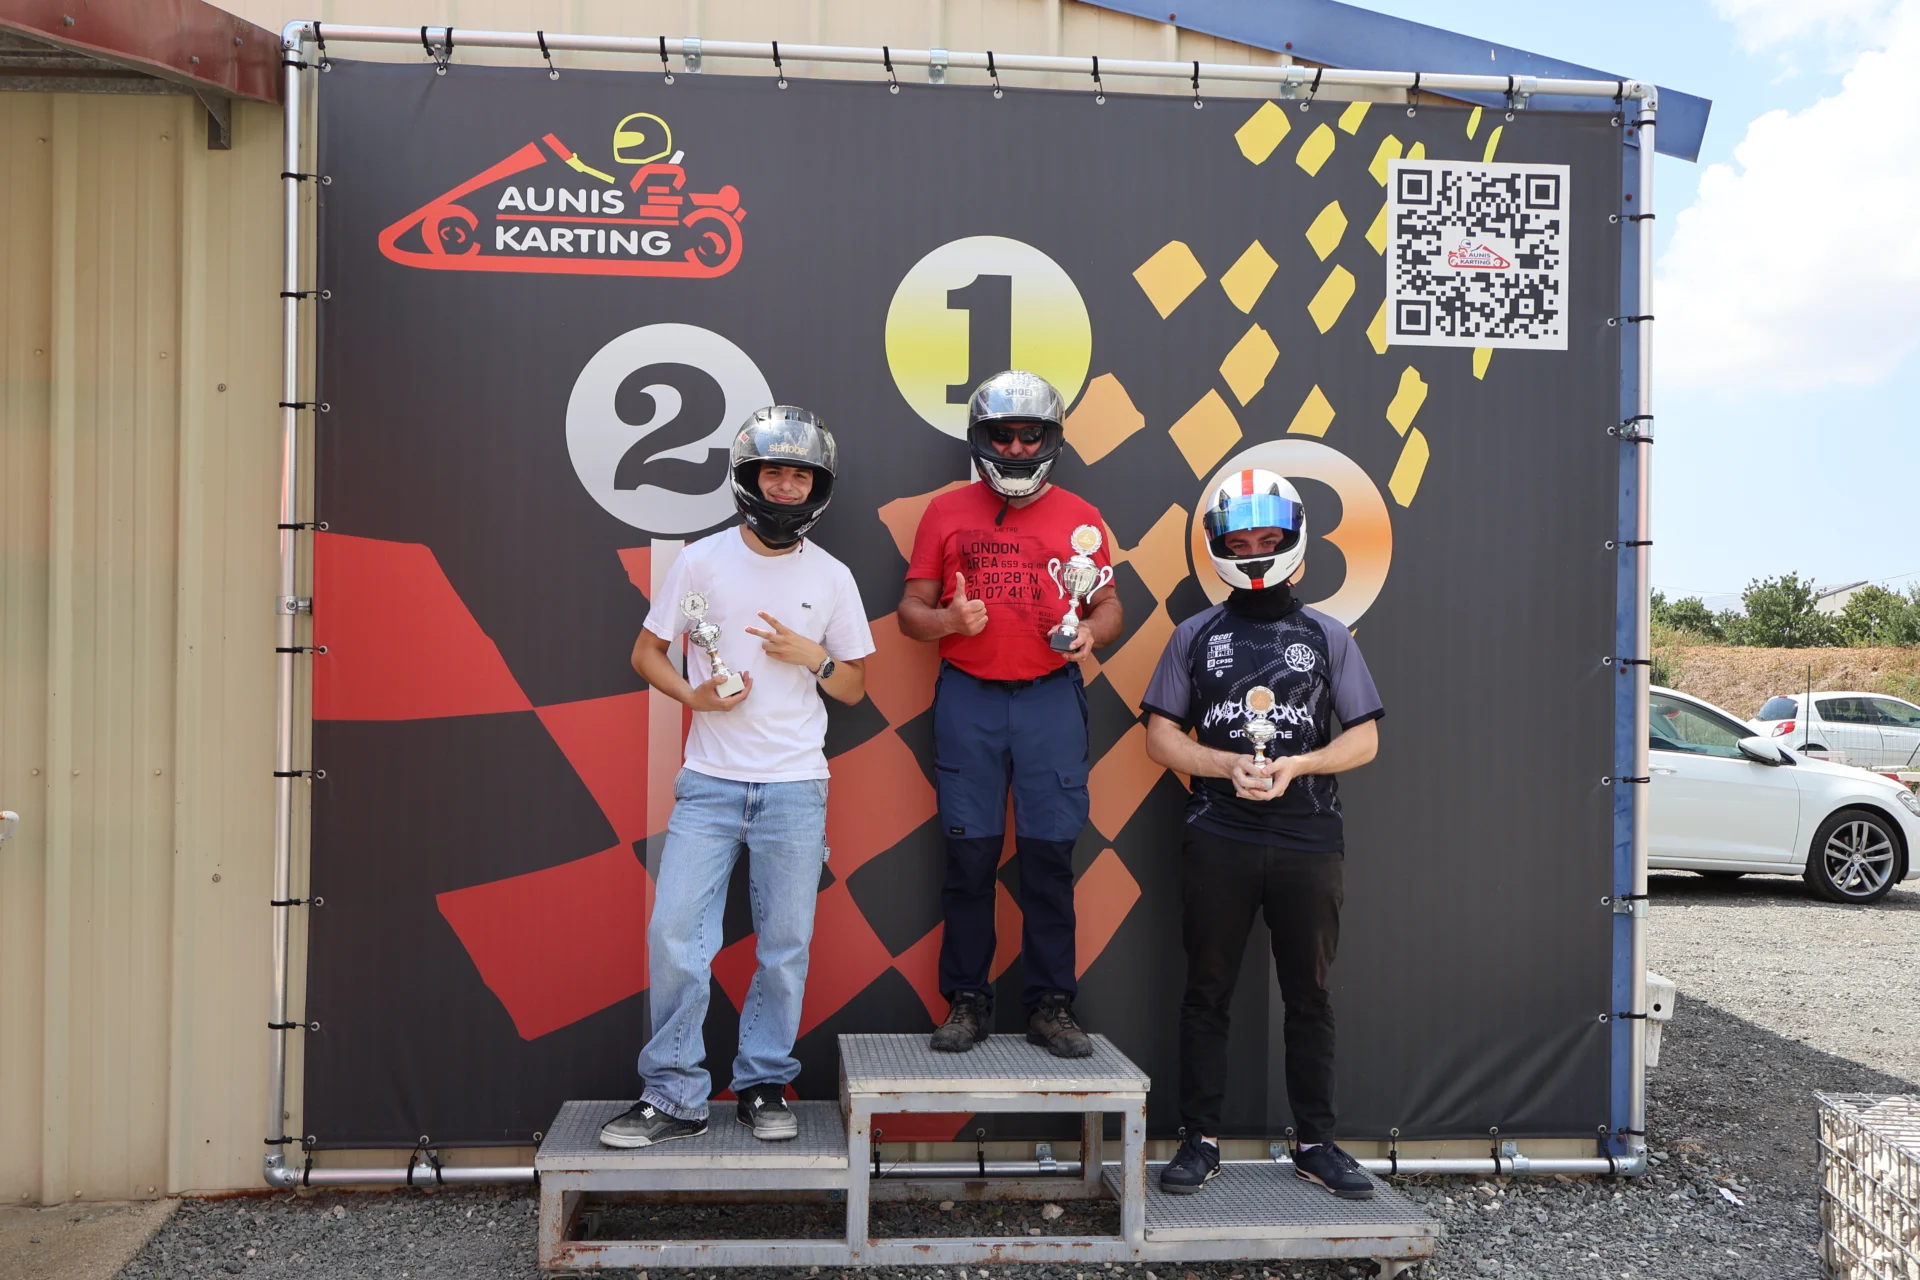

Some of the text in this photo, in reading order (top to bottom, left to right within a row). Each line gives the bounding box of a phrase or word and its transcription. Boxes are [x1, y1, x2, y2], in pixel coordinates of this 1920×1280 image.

[497, 186, 625, 214] AUNIS
[495, 225, 671, 256] KARTING
[946, 274, 1012, 404] 1
[1005, 388, 1033, 397] SHOEI
[614, 362, 730, 495] 2
[962, 542, 1020, 556] LONDON
[967, 557, 998, 570] AREA
[1001, 560, 1019, 568] 659
[1022, 562, 1034, 570] sq
